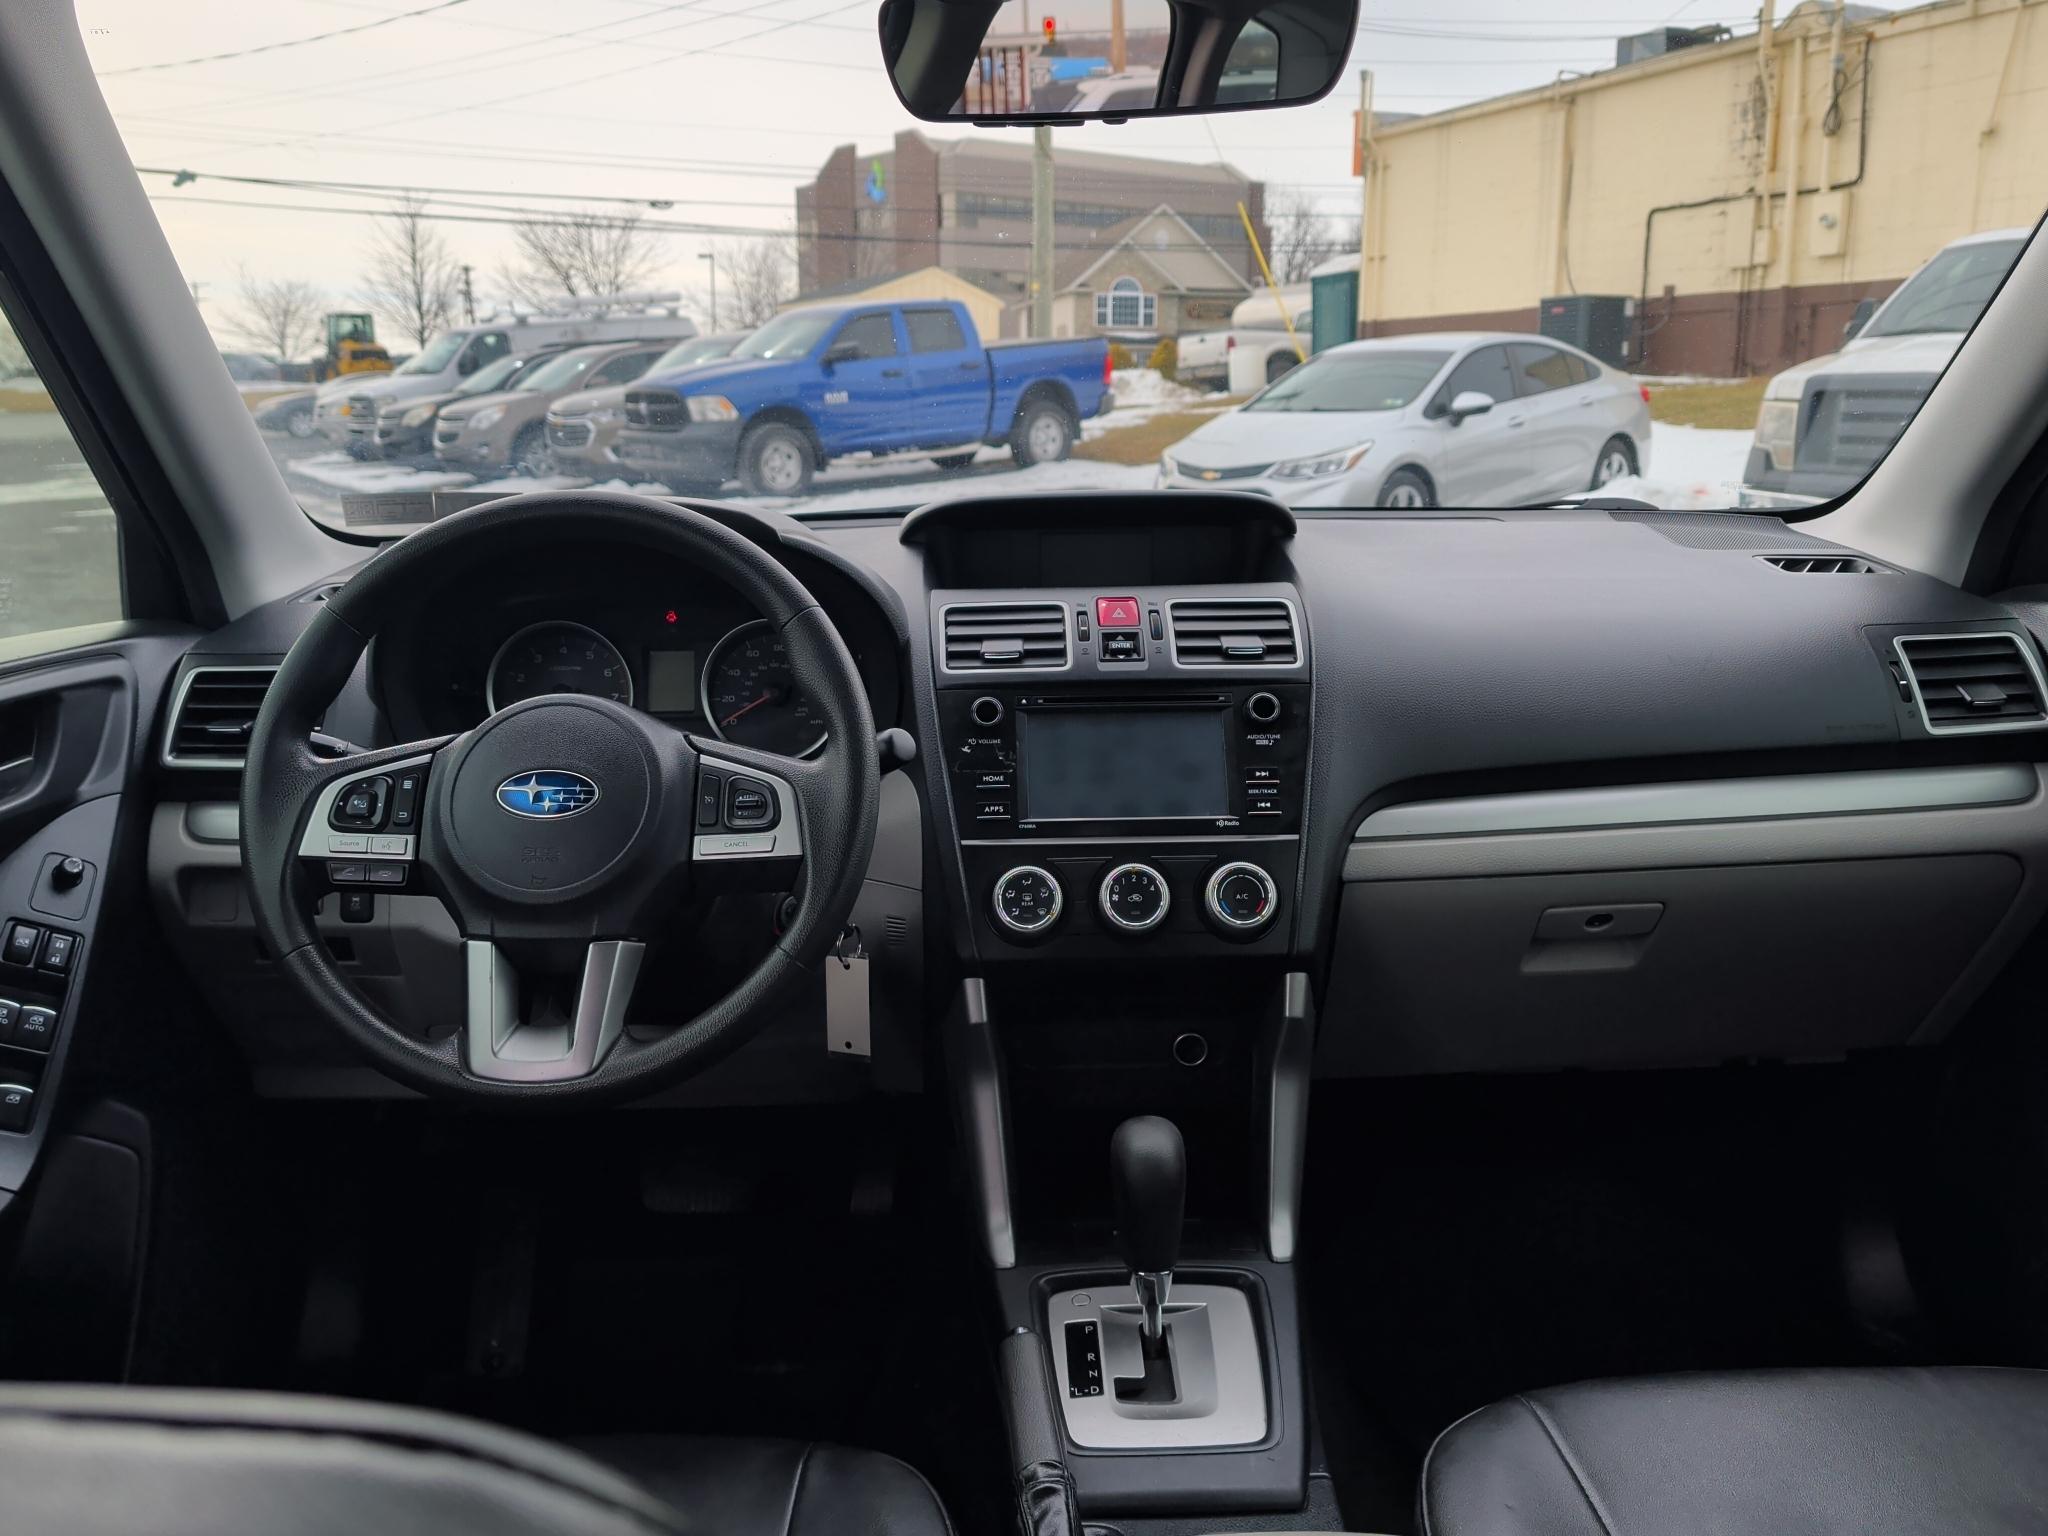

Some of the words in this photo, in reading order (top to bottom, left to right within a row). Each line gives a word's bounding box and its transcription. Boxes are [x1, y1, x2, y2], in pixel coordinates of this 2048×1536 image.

[603, 669, 612, 677] 6
[1085, 1326, 1094, 1334] P
[1087, 1353, 1096, 1361] R
[1089, 1369, 1098, 1378] N
